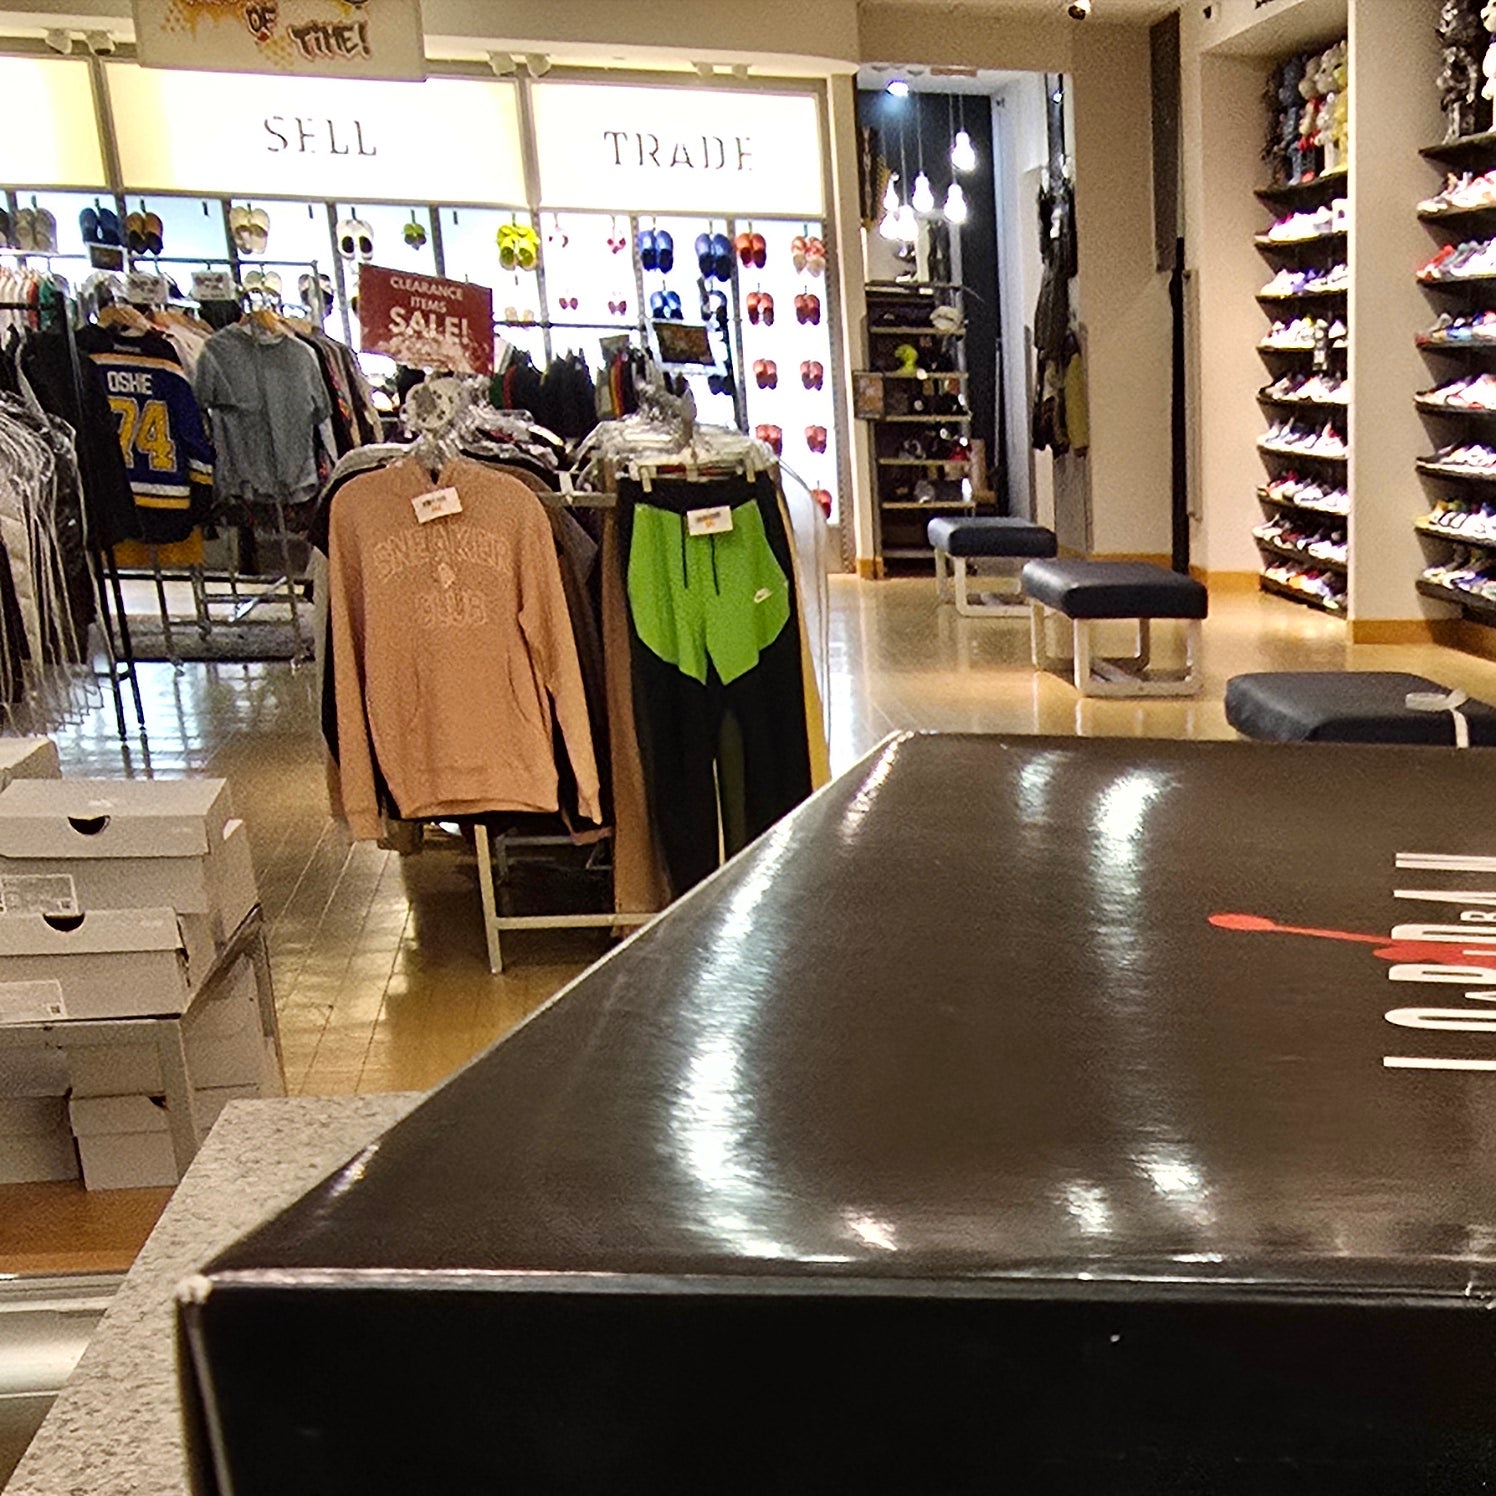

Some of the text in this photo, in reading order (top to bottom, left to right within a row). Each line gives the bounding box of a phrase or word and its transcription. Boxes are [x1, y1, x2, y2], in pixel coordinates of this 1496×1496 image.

[264, 116, 378, 157] SELL
[604, 130, 754, 172] TRADE
[390, 276, 464, 301] CLEARANCE
[410, 296, 447, 314] ITEMS
[388, 305, 470, 345] SALE!
